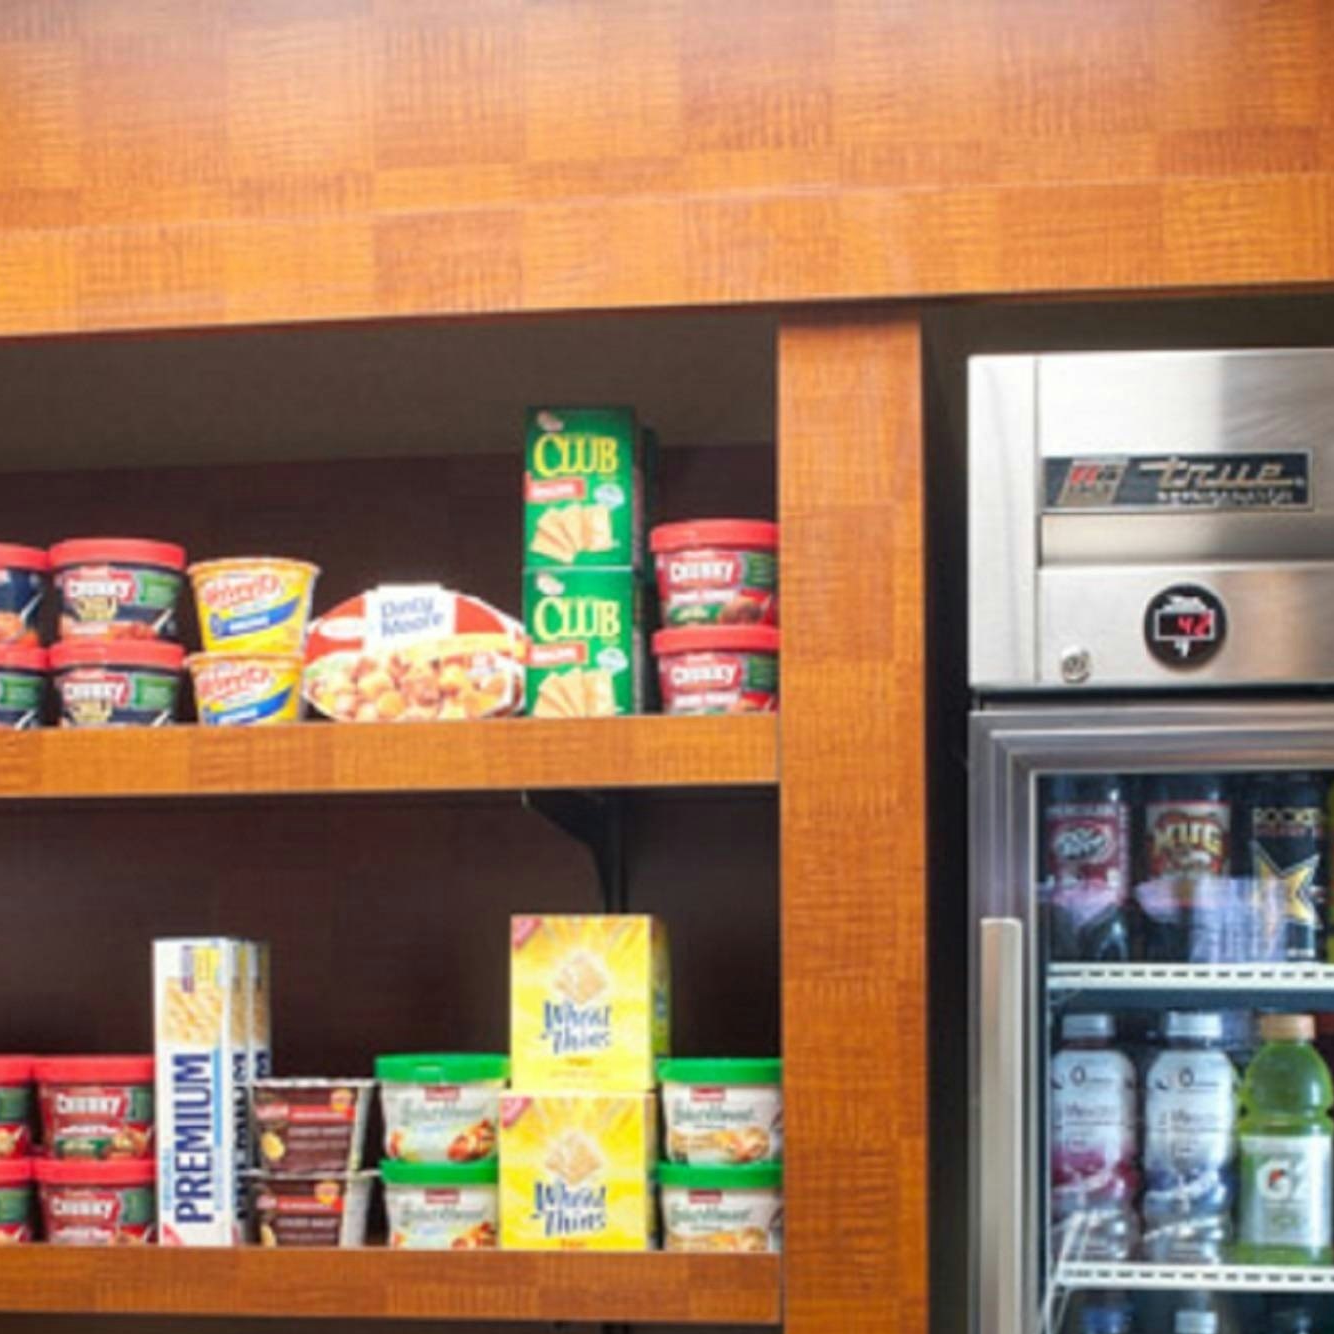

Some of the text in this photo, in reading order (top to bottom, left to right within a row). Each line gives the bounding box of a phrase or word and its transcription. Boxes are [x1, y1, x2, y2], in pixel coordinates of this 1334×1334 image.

[534, 434, 619, 477] CLUB
[534, 597, 621, 641] CLUB
[173, 1052, 213, 1226] PREMIUM
[533, 1181, 608, 1211] Wheat
